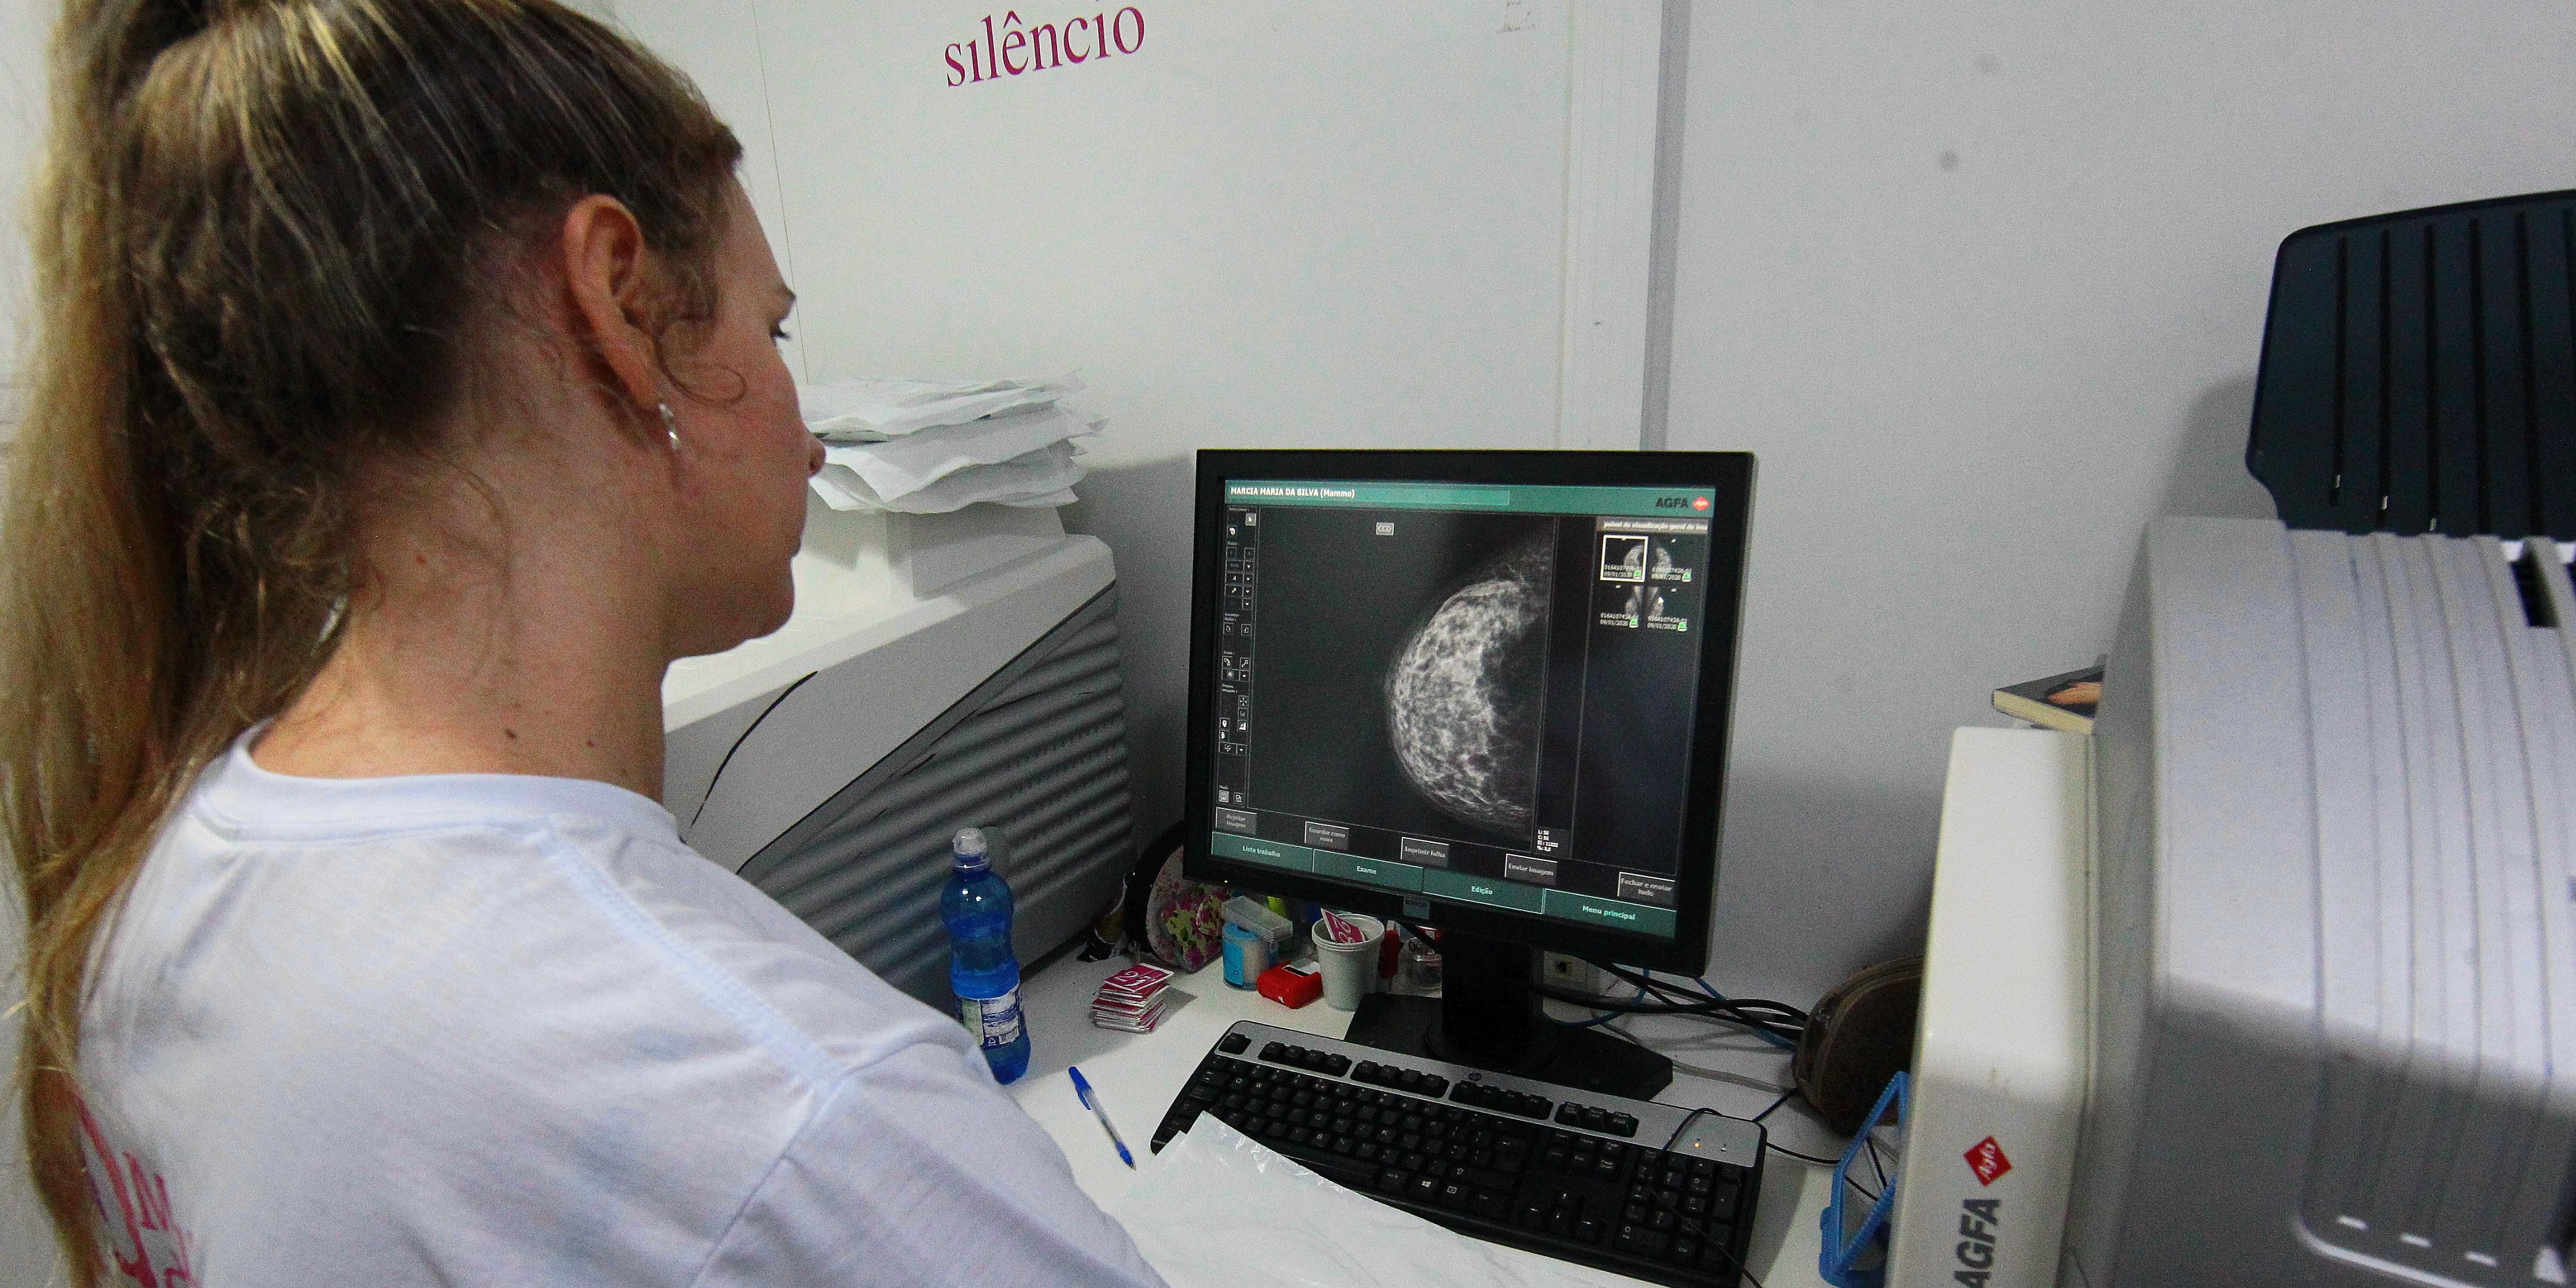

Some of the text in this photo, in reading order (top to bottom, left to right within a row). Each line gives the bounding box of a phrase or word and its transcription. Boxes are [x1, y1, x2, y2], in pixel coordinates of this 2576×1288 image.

[945, 7, 1145, 88] silêncio
[1320, 489, 1355, 499] (Mammo)
[1656, 497, 1688, 508] AGFA
[1257, 847, 1280, 857] trabalho
[1405, 846, 1445, 858] Imprimir folha
[1357, 866, 1376, 874] Exame
[1508, 863, 1528, 872] Enviar
[1472, 886, 1493, 895] Edição
[1582, 905, 1636, 920] Menu principal
[1953, 1198, 2000, 1288] AGFA
